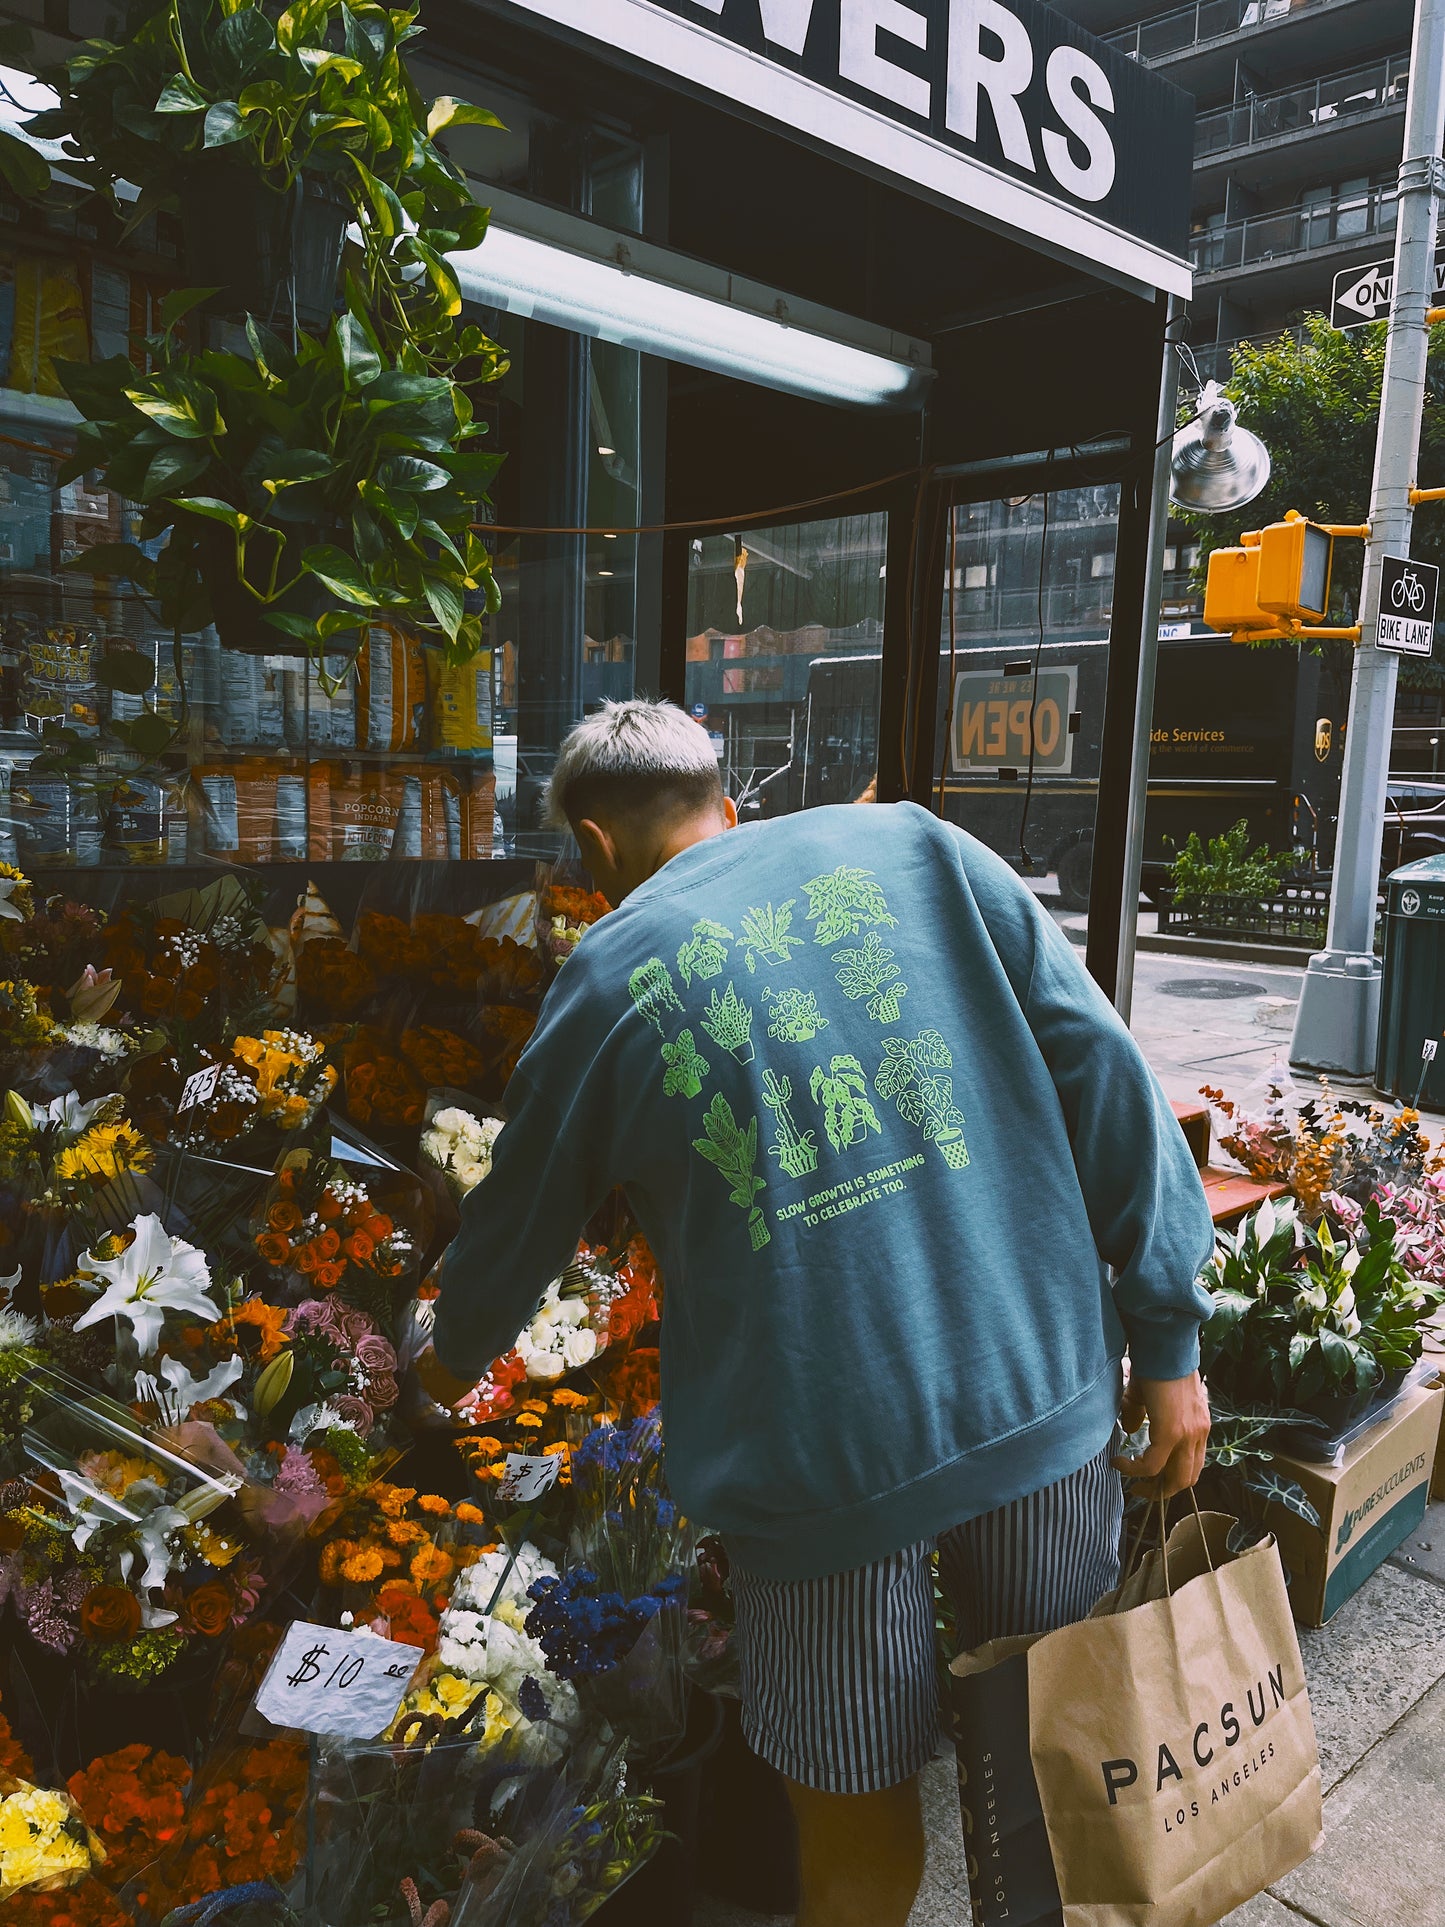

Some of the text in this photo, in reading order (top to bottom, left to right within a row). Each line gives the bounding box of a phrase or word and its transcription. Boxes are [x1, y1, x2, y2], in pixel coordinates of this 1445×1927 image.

[688, 0, 1118, 202] ERS
[1355, 279, 1392, 306] ON
[1380, 618, 1430, 646] BIKE LANE
[29, 644, 93, 666] SMART
[33, 661, 91, 682] PUFFS
[1159, 744, 1174, 752] the
[1175, 744, 1198, 752] world
[1210, 745, 1254, 753] commerce
[1172, 728, 1225, 742] Services
[344, 803, 400, 817] POPCORN
[354, 813, 390, 824] INDIANA
[347, 832, 392, 845] KETTLE CORN
[184, 1069, 217, 1104] $25
[775, 1153, 926, 1221] SLOW GROWTH IS SOMETHING
[802, 1178, 908, 1228] TO CELEBRATE TOO.
[1101, 1663, 1285, 1805] PACSUN
[1164, 1742, 1275, 1833] LOS ANGELES
[982, 1751, 1009, 1919] LOS ANGELES
